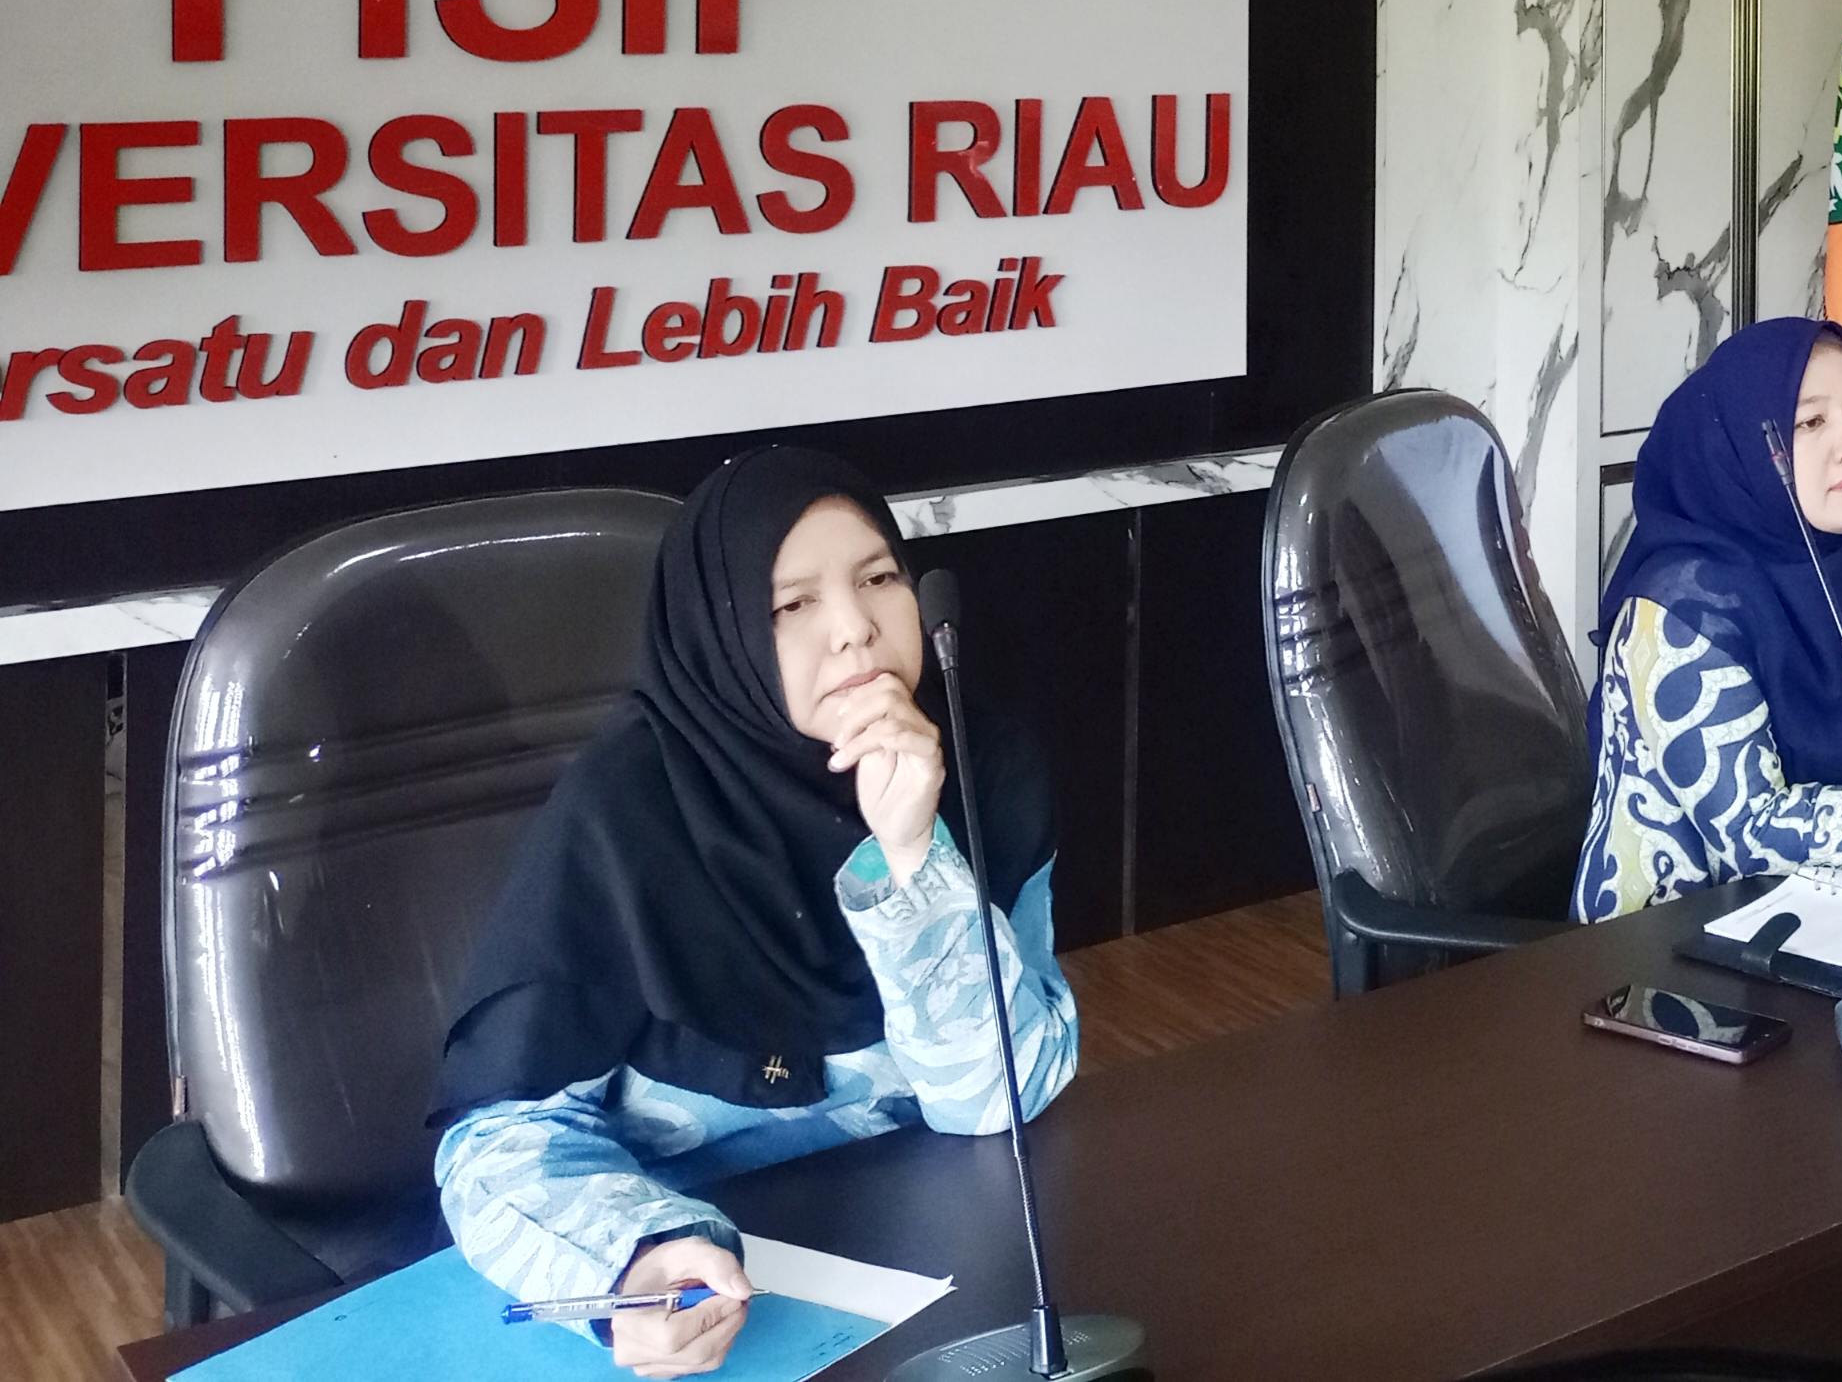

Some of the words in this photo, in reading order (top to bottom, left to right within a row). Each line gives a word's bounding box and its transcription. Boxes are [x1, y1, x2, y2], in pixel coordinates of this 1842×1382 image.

[906, 92, 1231, 223] RIAU
[0, 315, 314, 420] rsatu
[344, 299, 547, 390] dan
[576, 271, 846, 370] Lebih
[868, 255, 1066, 344] Baik
